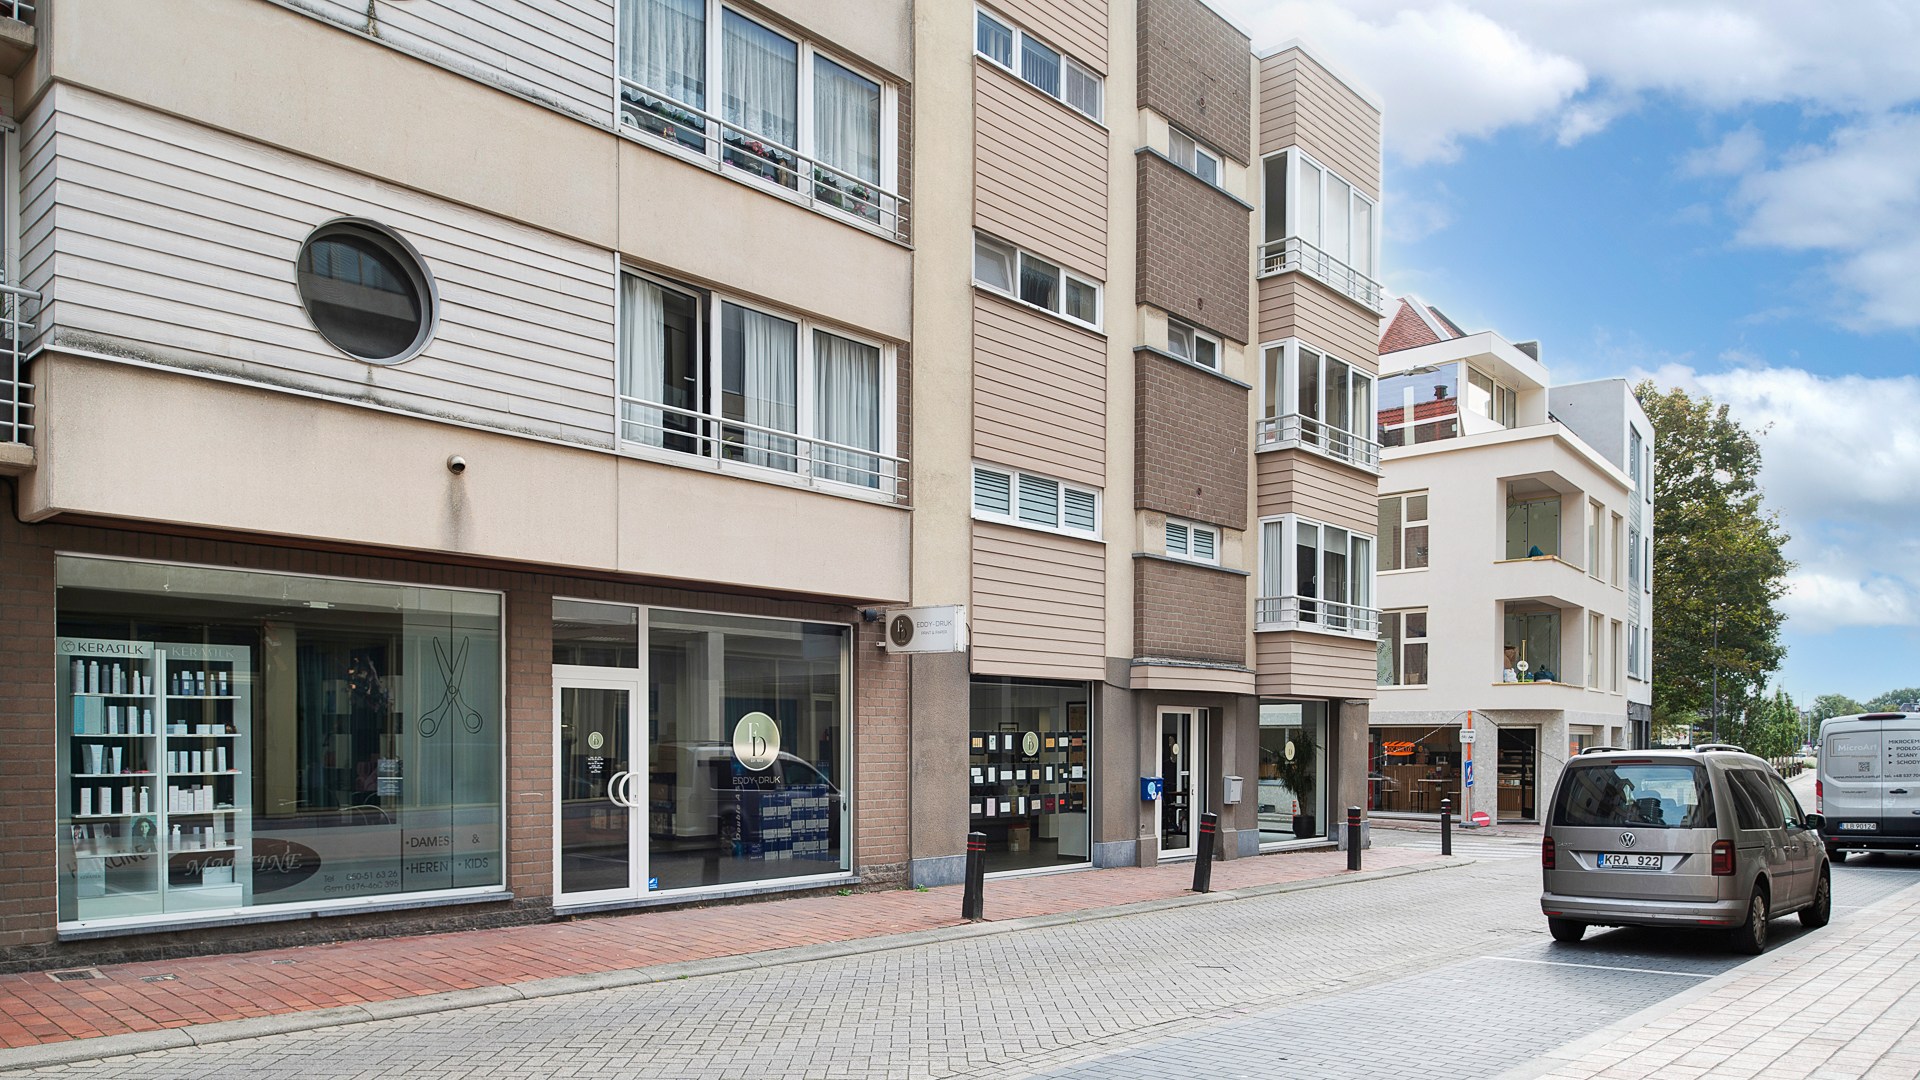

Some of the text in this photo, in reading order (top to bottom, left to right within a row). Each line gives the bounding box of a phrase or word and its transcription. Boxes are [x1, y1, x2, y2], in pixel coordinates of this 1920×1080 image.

[916, 620, 952, 628] EDDY-DRUK
[78, 642, 144, 655] KERASILK
[1838, 744, 1877, 752] MicroArt
[732, 775, 781, 785] EDDY-DRUK
[410, 833, 480, 848] DAMES &
[464, 857, 489, 869] KIDS
[1604, 855, 1660, 867] KRA 922
[410, 861, 449, 874] HEREN
[375, 870, 386, 879] 63
[387, 869, 398, 878] 26
[384, 879, 400, 889] 395
